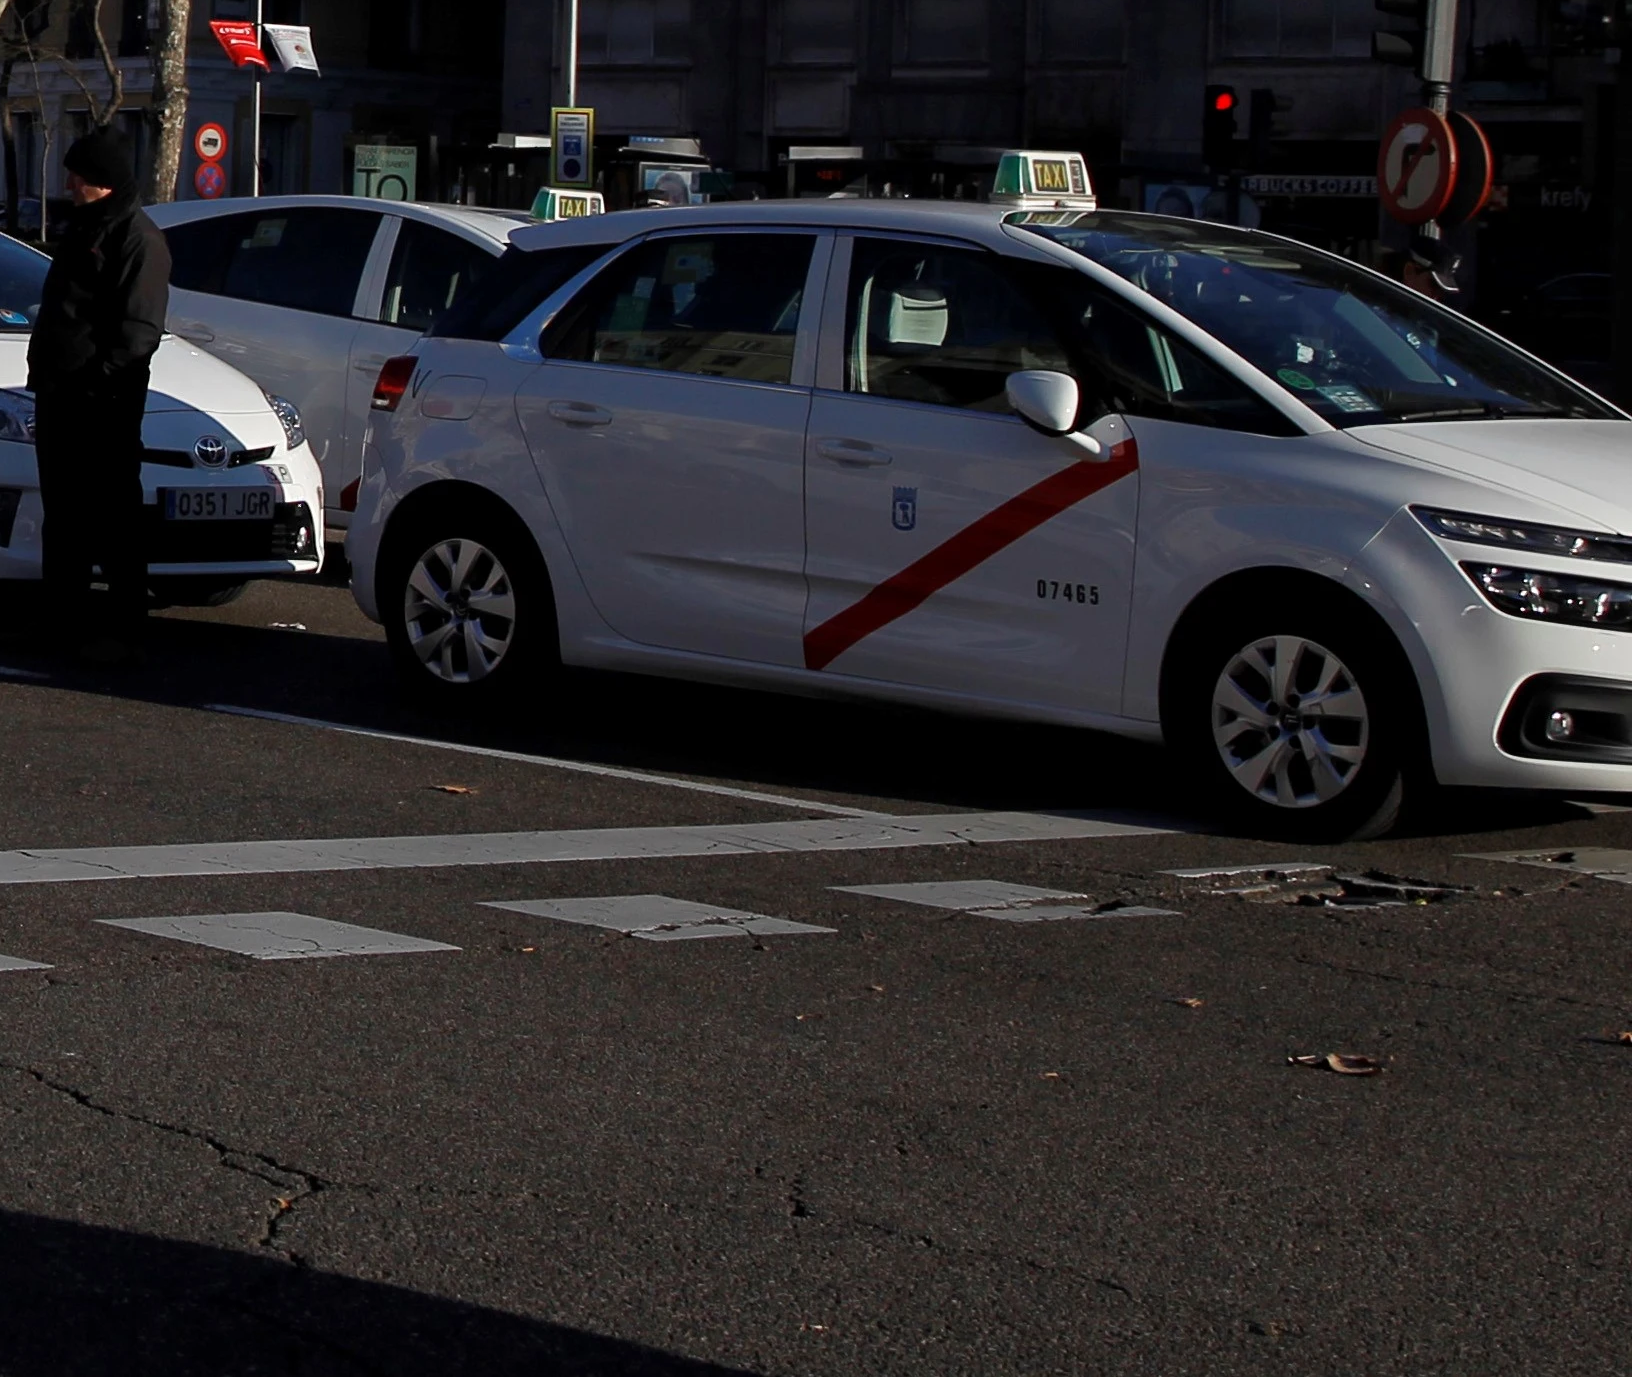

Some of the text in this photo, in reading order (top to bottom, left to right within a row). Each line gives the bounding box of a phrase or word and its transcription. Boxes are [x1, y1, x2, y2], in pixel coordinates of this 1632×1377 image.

[1035, 164, 1067, 188] TAXI
[561, 199, 586, 217] TAXI
[179, 492, 271, 516] 0351 JGR
[1037, 579, 1099, 605] 07465
